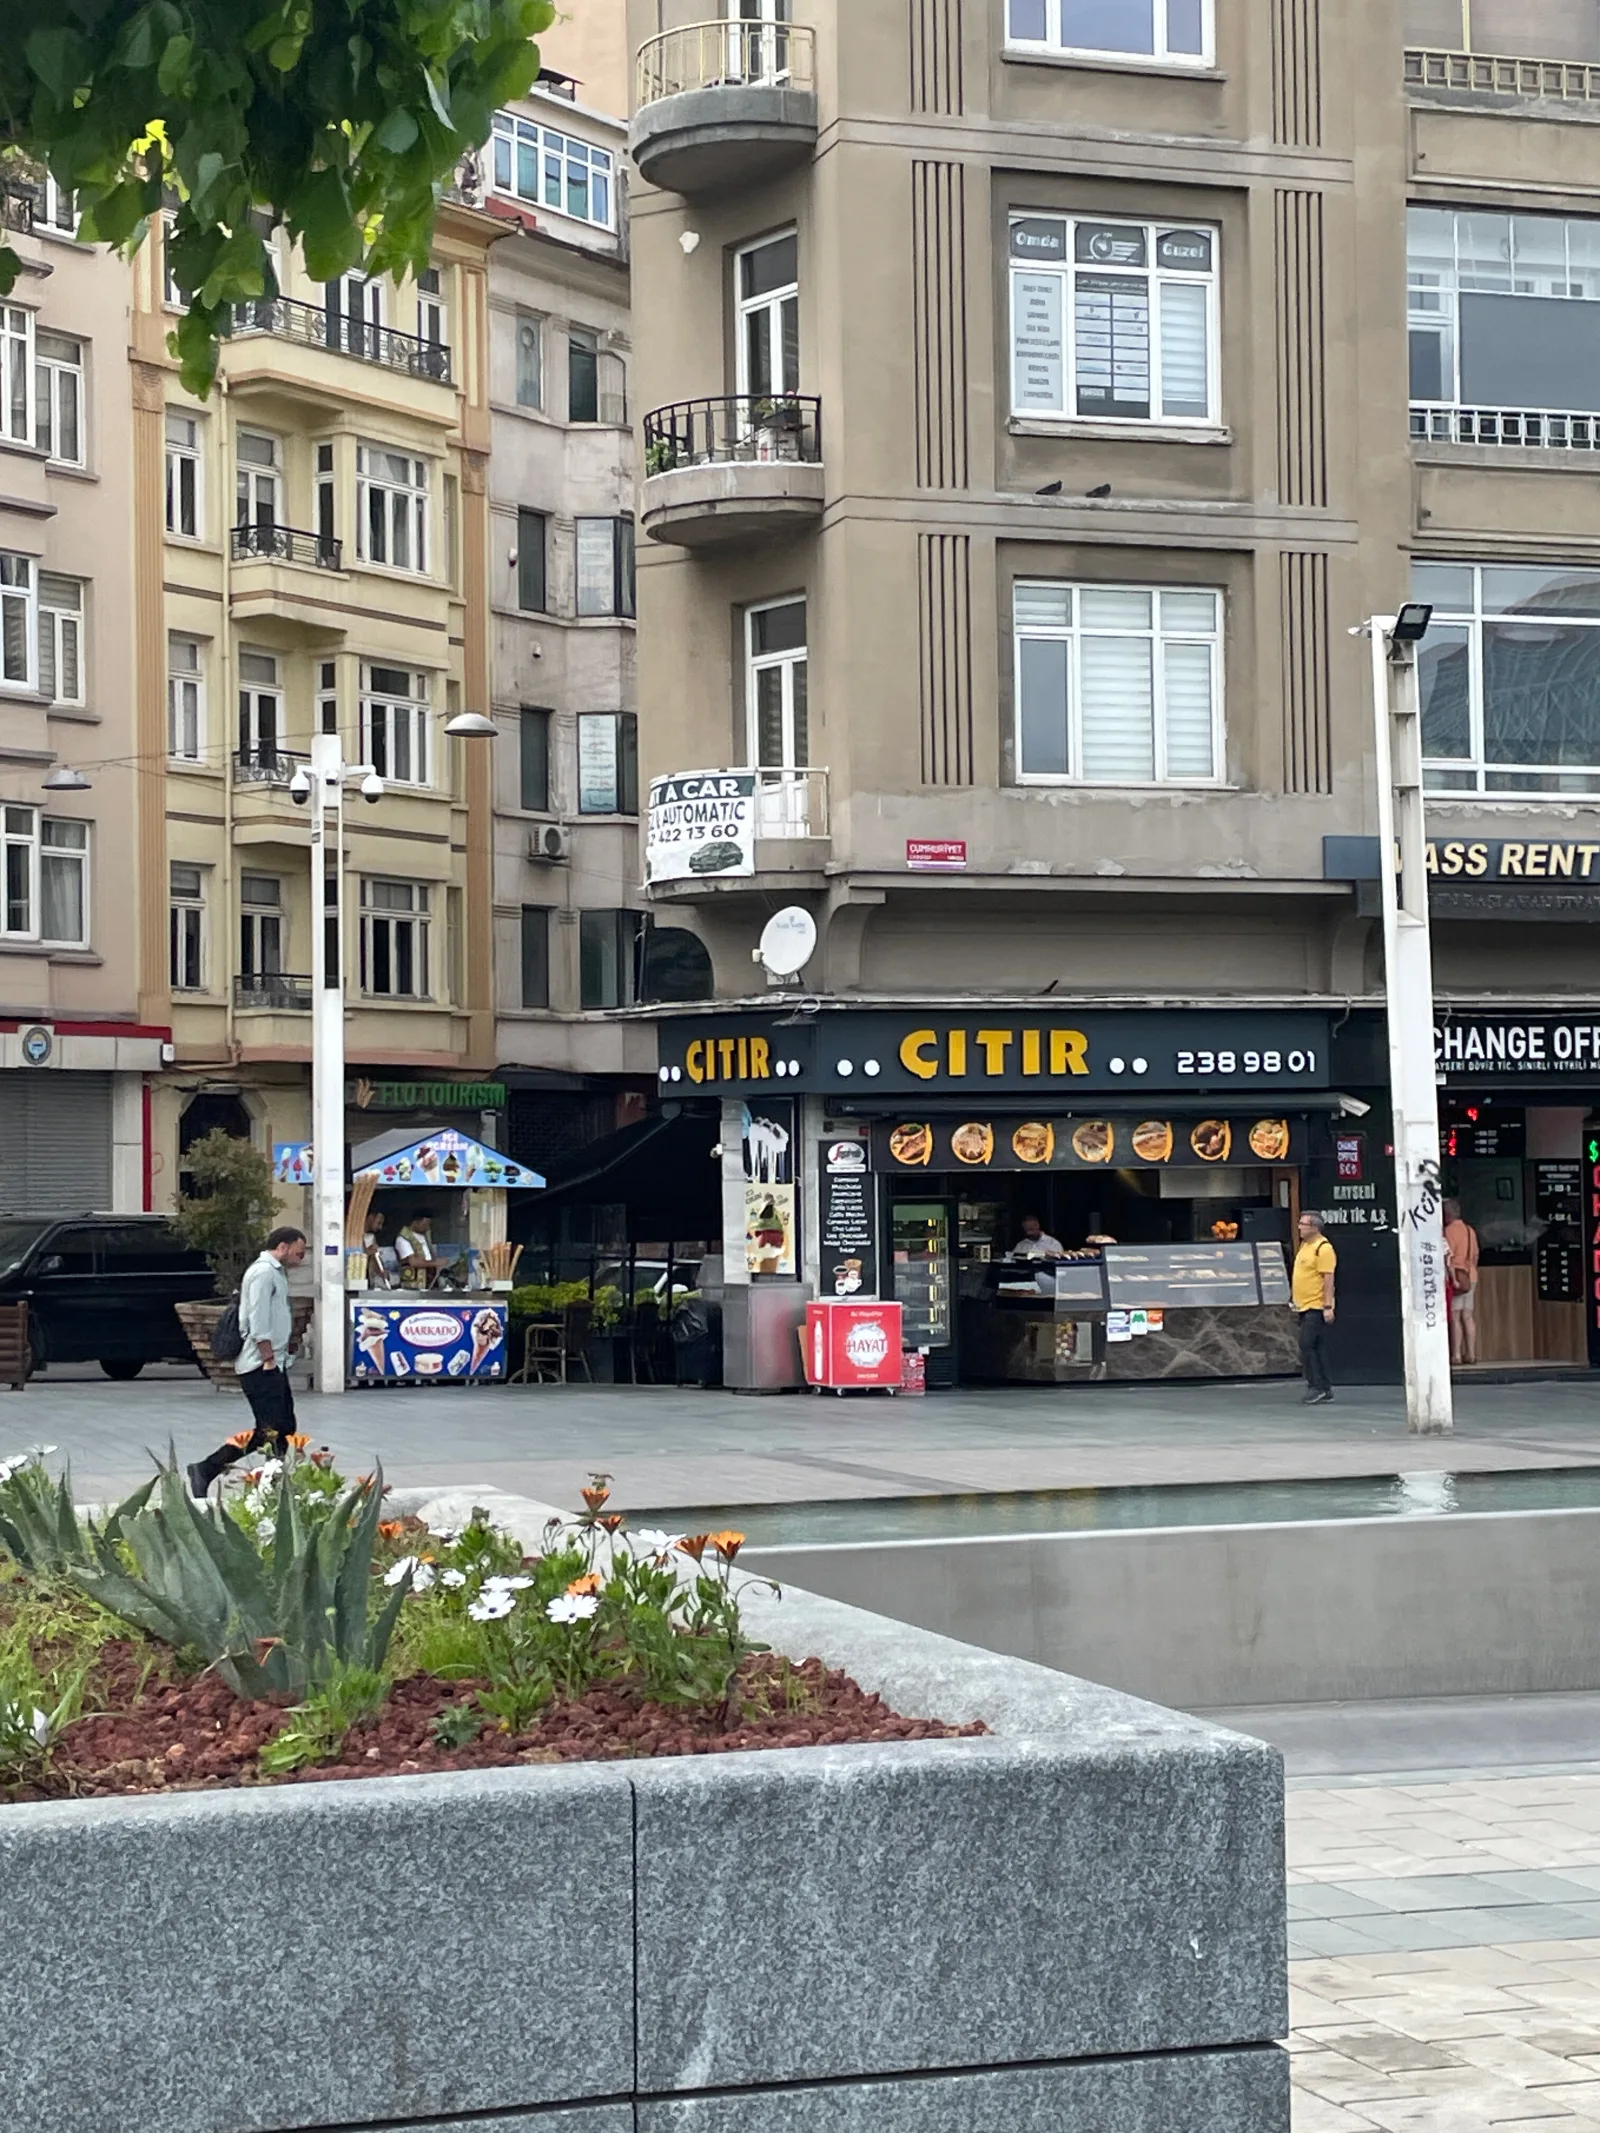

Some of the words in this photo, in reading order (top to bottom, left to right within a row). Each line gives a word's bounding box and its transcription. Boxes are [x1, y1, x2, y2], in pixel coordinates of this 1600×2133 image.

[682, 778, 741, 798] CAR
[662, 801, 746, 826] AUTOMATIC
[711, 823, 739, 838] 60
[1500, 843, 1600, 877] RENT
[1177, 1051, 1236, 1073] 238
[1243, 1050, 1281, 1072] 98
[1288, 1050, 1315, 1073] 01
[847, 1339, 887, 1353] HAYAT
